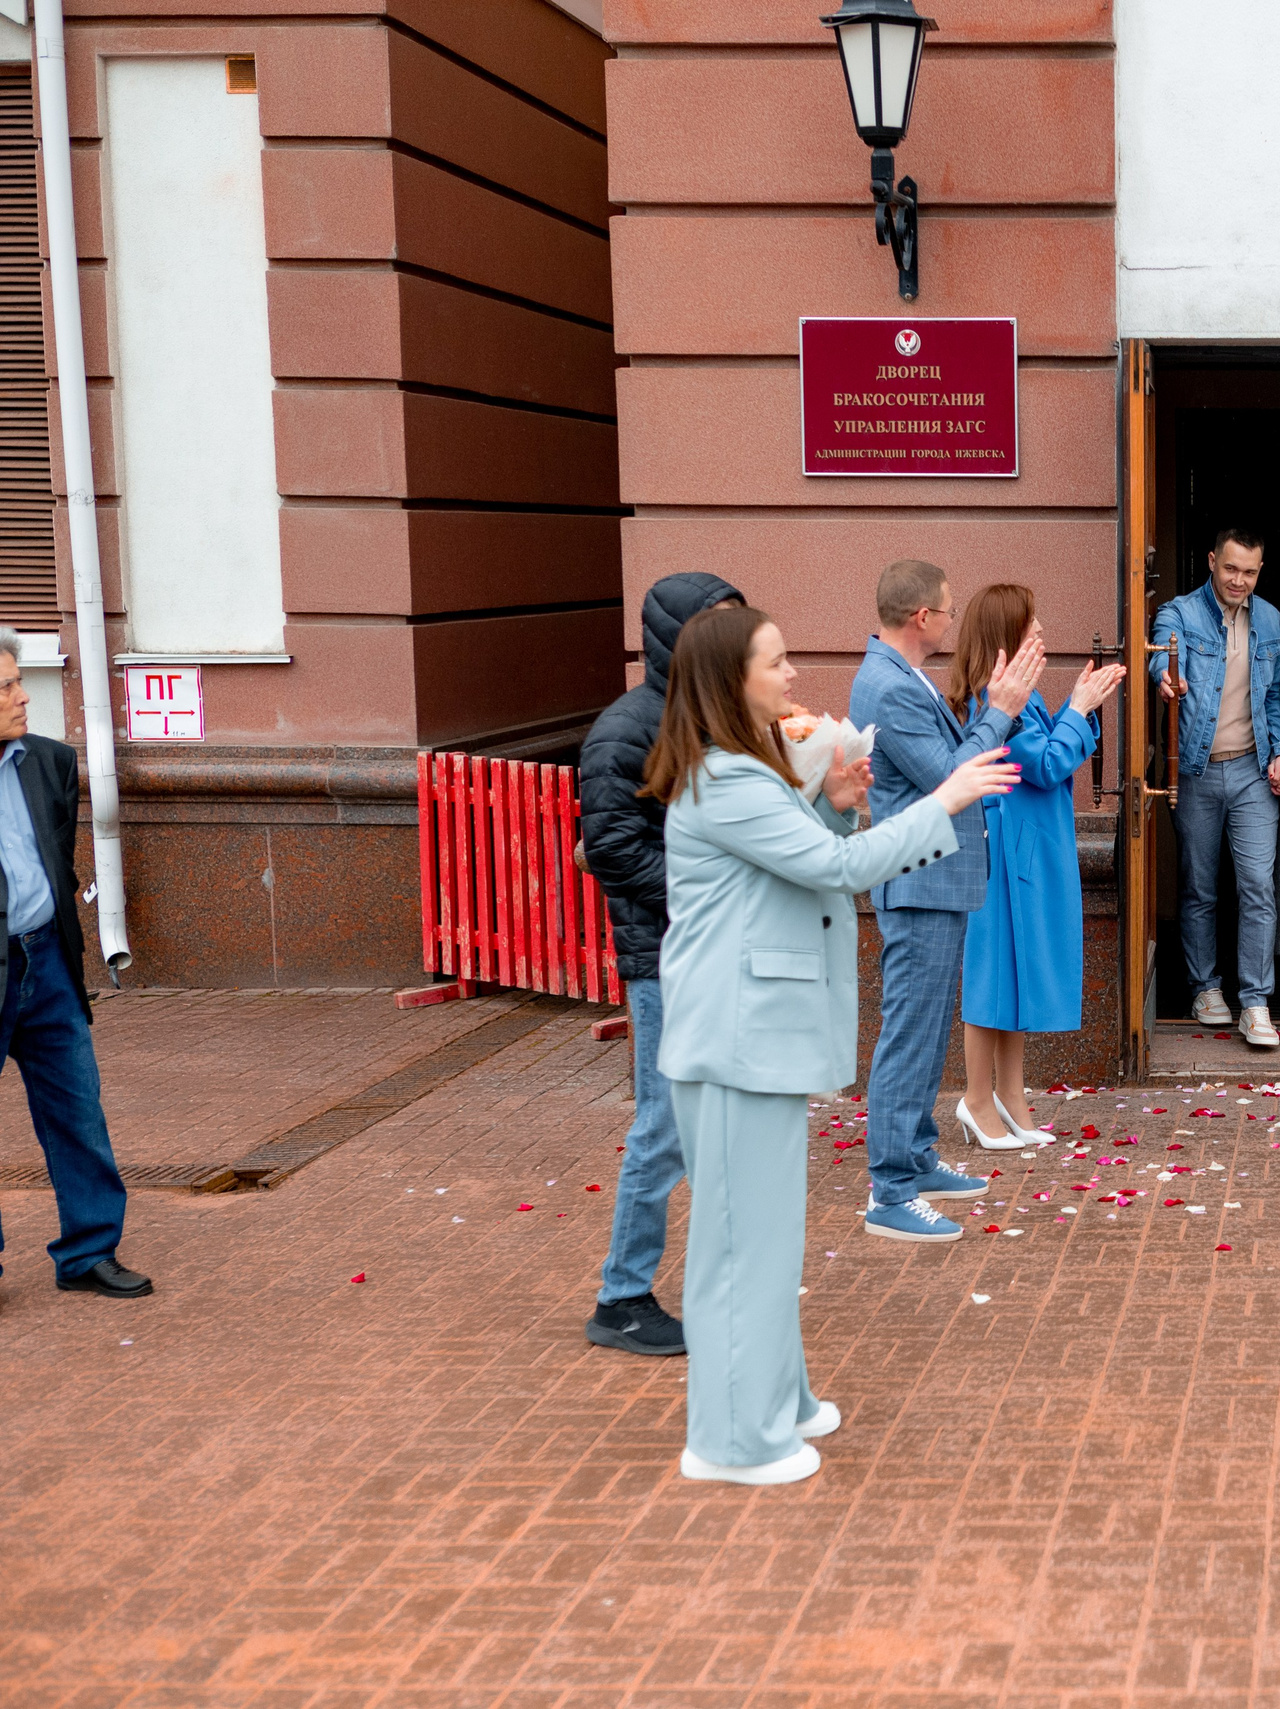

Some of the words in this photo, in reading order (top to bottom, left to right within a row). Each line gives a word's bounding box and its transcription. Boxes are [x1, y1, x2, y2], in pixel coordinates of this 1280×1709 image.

[875, 365, 942, 381] ДВОРЕЦ
[833, 393, 986, 406] БРАКОСОЧЕТАНИЯ
[833, 420, 942, 434] УПРАВЛЕНИЯ
[945, 420, 986, 434] ЗАГС
[814, 449, 907, 459] АДМИНИСТРАЦИИ
[911, 449, 951, 459] ГОРОДА
[955, 449, 1006, 459] ИЖЕВСКА
[145, 675, 182, 700] ПГ
